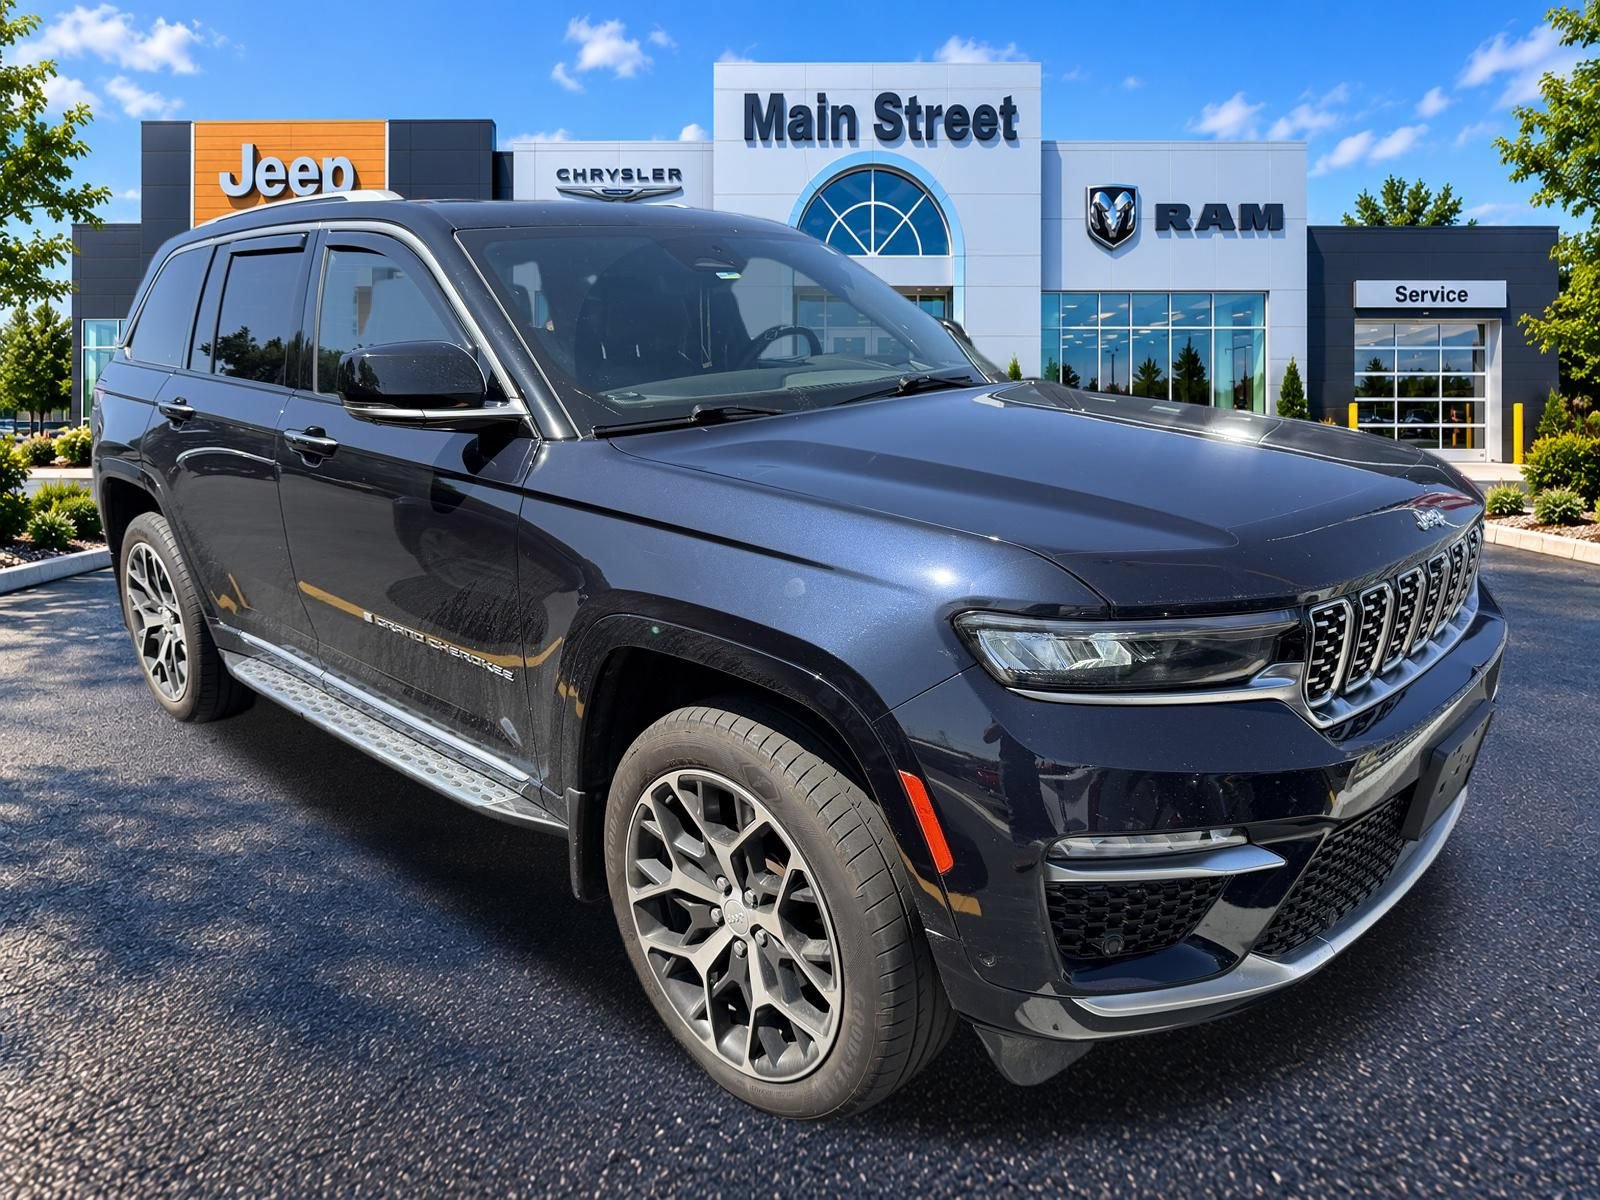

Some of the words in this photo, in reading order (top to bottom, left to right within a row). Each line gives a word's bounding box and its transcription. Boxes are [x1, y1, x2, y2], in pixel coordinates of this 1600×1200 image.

[743, 92, 857, 141] Main
[873, 91, 1018, 142] Street
[218, 143, 355, 197] Jeep
[556, 168, 682, 182] CHRYSLER
[1155, 203, 1284, 231] RAM
[1395, 285, 1469, 303] Service
[425, 637, 515, 682] CHEROKEE
